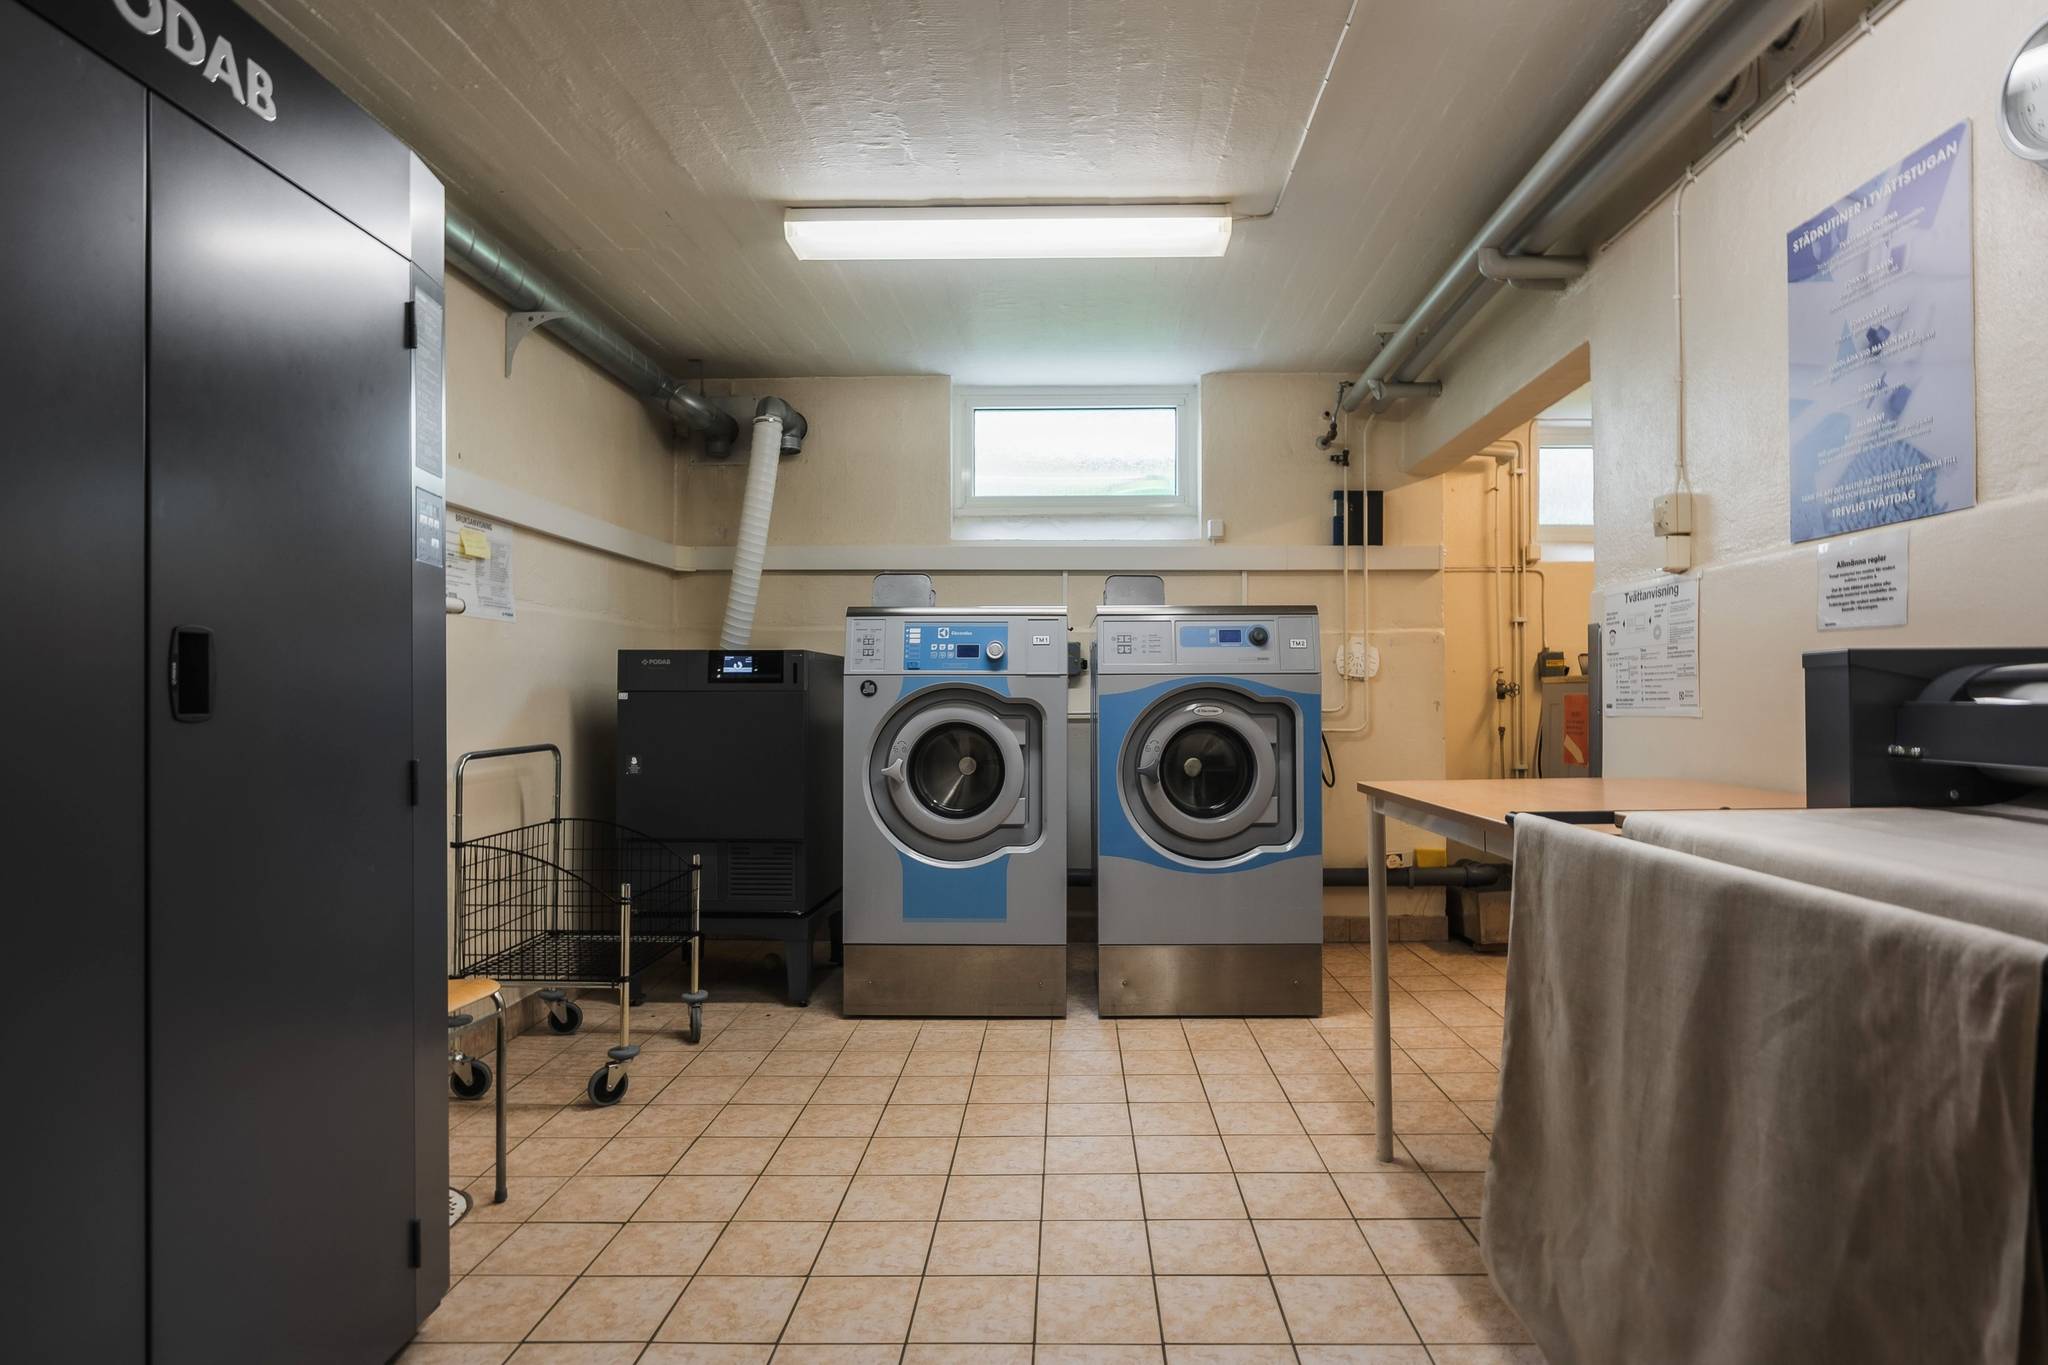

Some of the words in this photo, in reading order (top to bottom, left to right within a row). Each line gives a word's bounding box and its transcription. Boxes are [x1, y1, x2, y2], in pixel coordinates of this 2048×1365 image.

[1792, 199, 1862, 253] STÄDRUTINER
[1870, 140, 1958, 206] TVÄTTSTUGAN
[1832, 502, 1866, 518] TREVLIG
[1868, 488, 1916, 511] TVÄTTDAG
[1836, 558, 1867, 569] Allmänna
[1867, 554, 1887, 565] regler
[1624, 584, 1680, 604] Tvättanvisning
[1034, 636, 1049, 644] TM1
[1290, 640, 1306, 648] TM2
